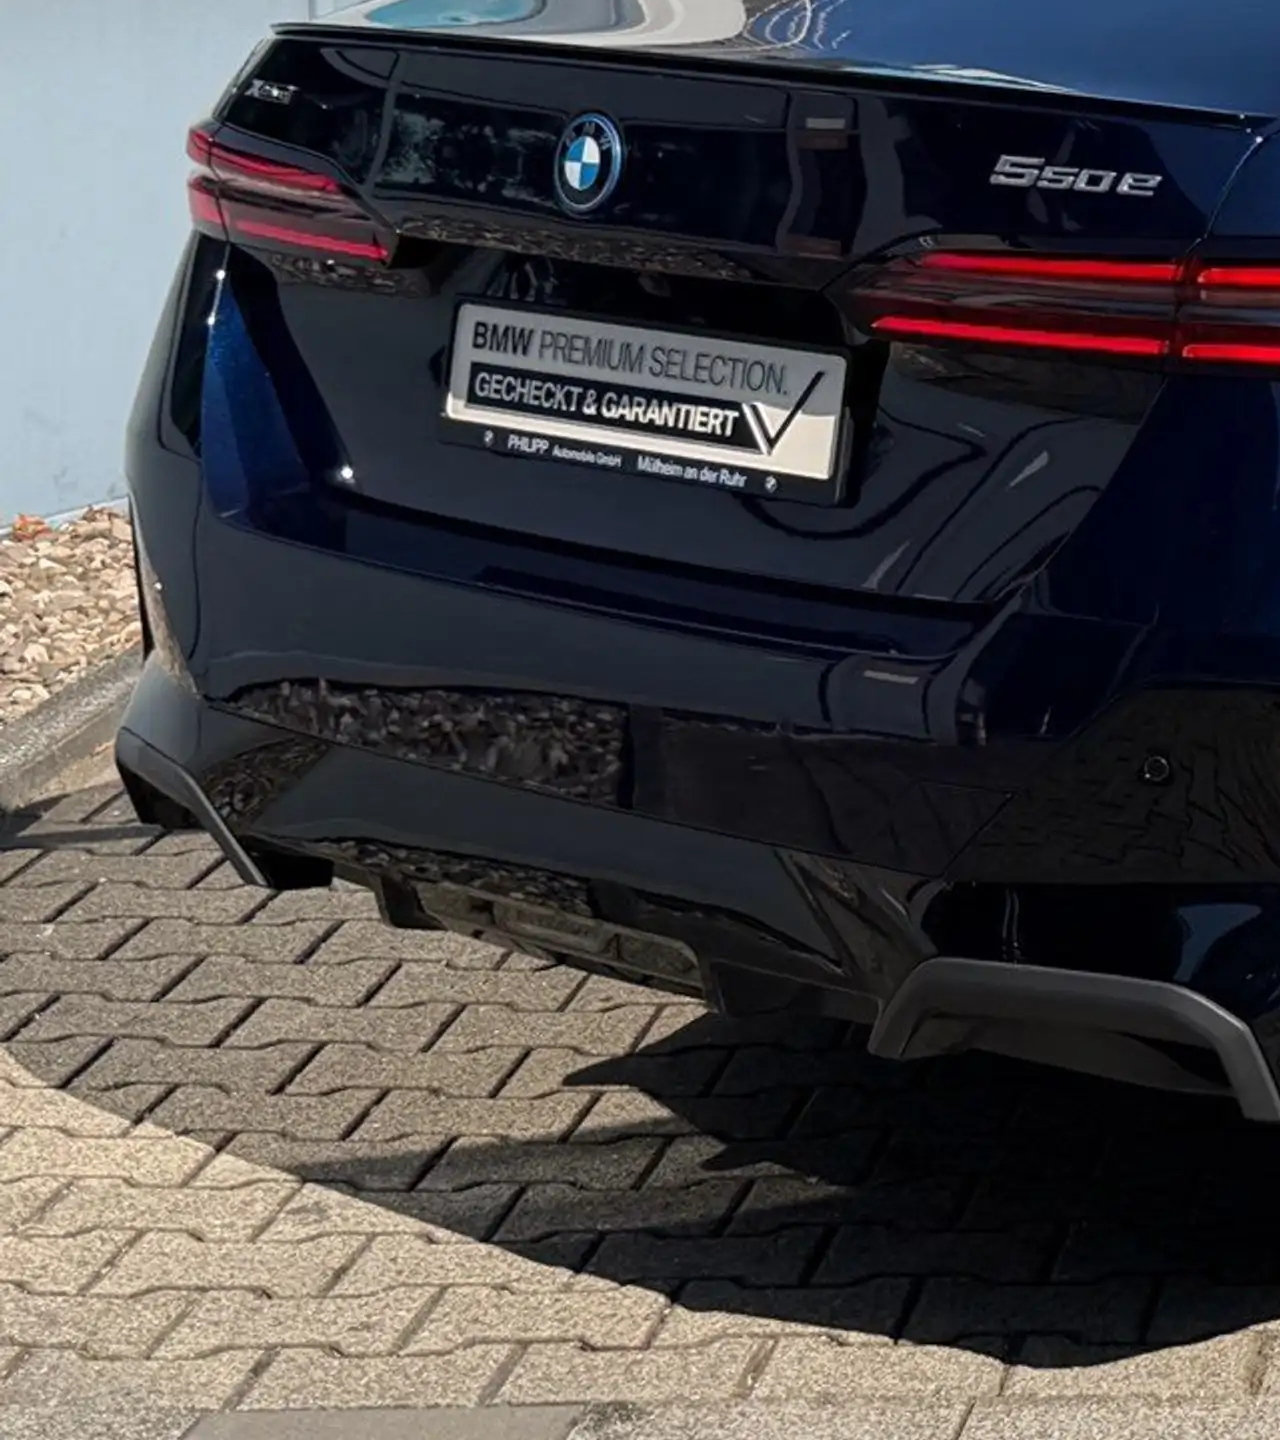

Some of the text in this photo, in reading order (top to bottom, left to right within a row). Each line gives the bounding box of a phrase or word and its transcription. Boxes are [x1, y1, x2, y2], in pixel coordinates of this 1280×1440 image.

[988, 154, 1163, 196] 550e
[473, 320, 789, 396] BMW PREMIUM SELECTION.
[474, 371, 739, 438] GECHECKT & GARANTIERT
